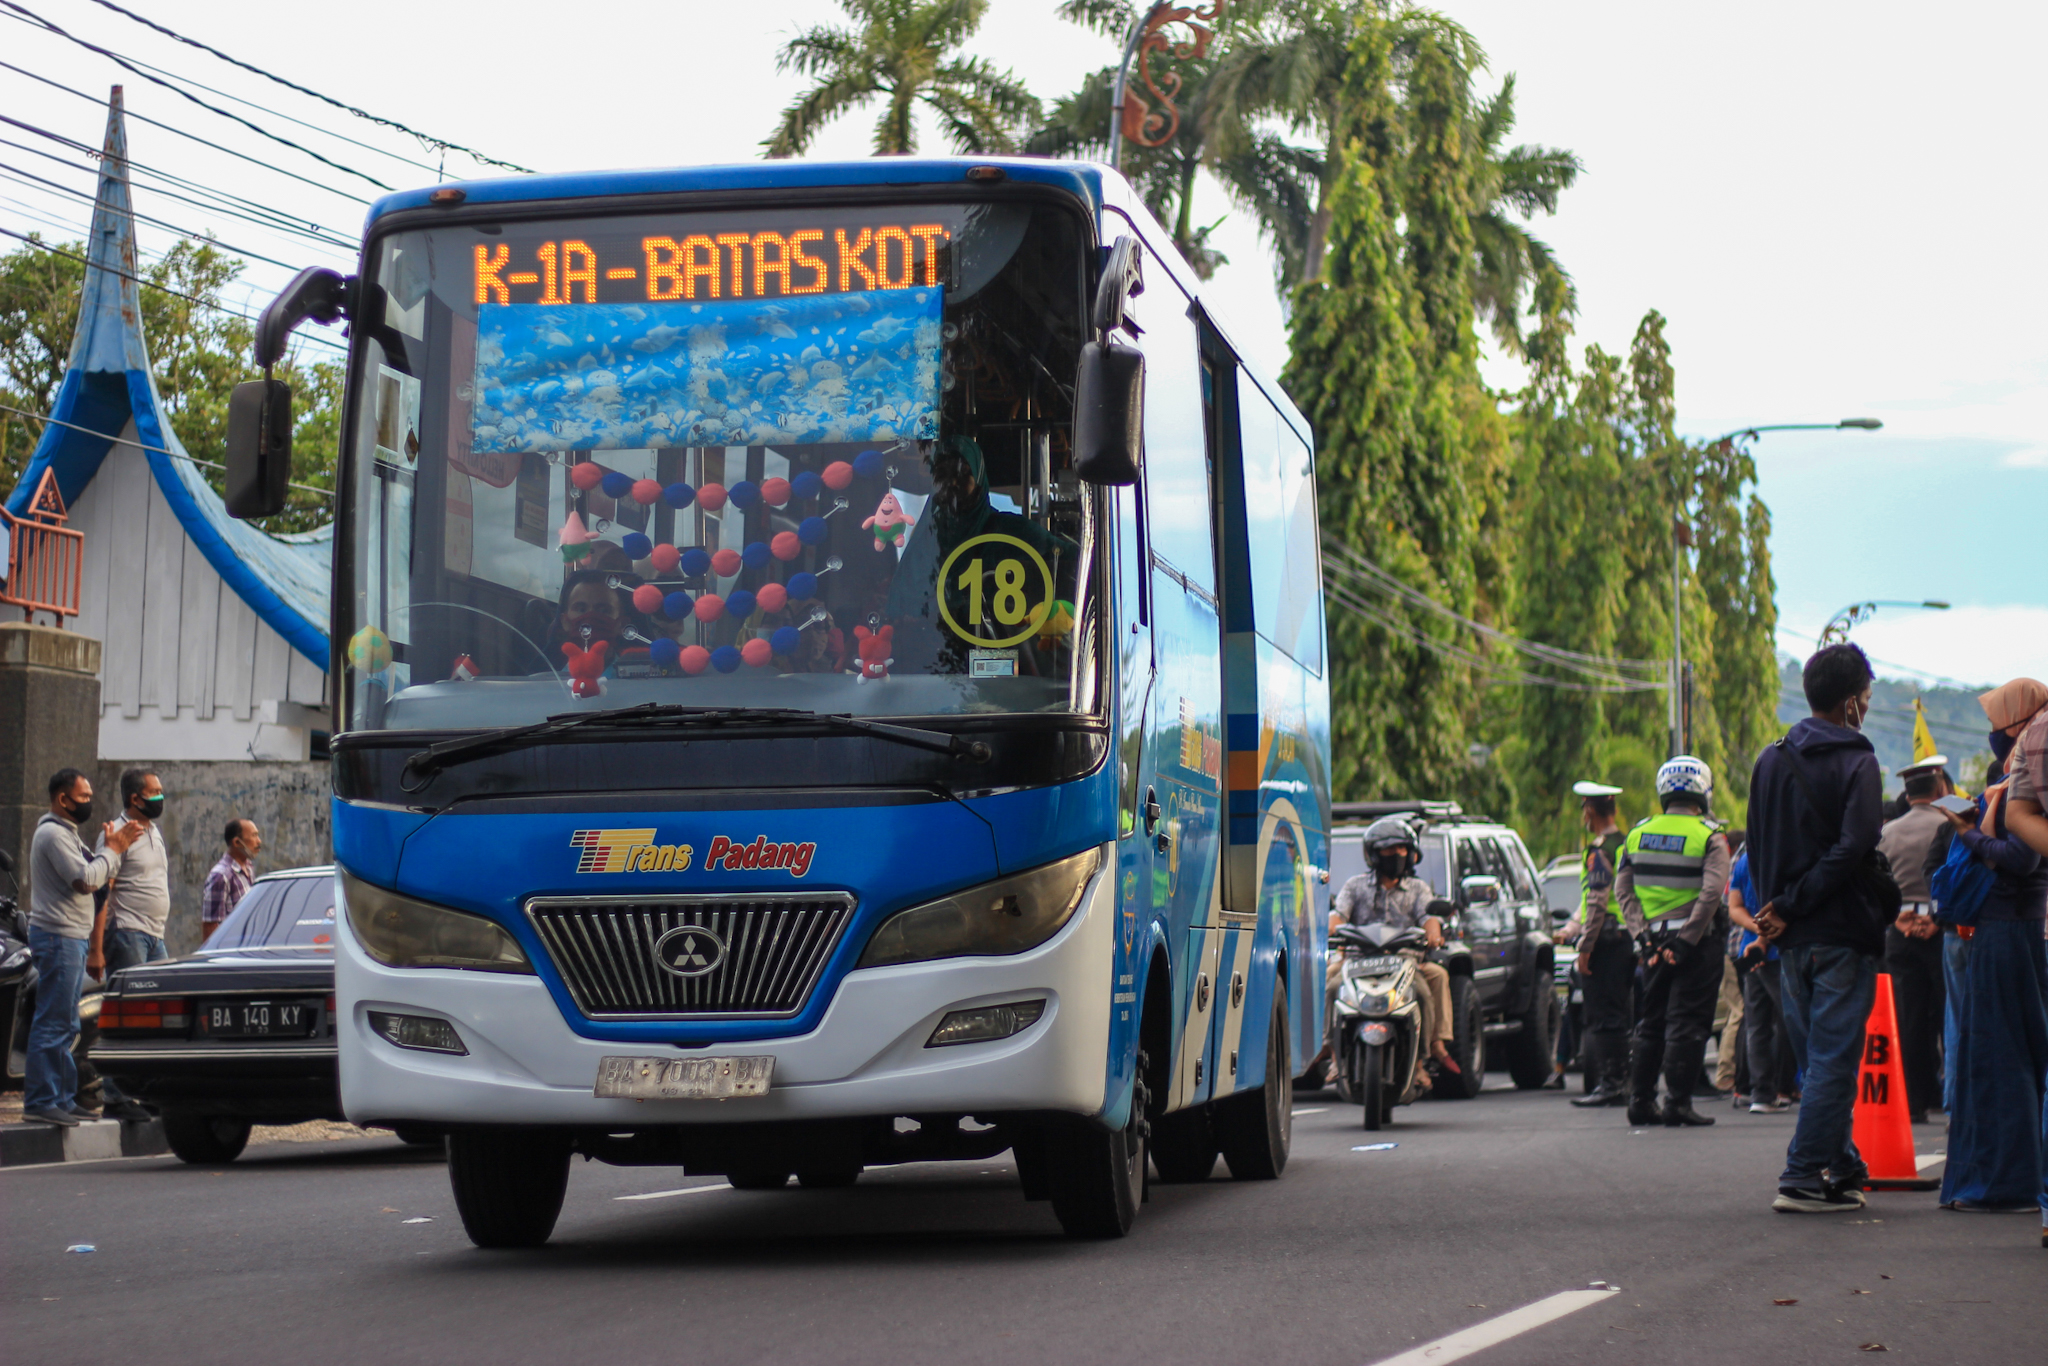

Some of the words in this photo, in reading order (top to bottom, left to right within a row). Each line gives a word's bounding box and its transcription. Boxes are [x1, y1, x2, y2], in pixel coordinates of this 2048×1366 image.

[642, 229, 828, 301] BATAS
[835, 224, 950, 292] KOT
[958, 558, 1027, 626] 18
[569, 828, 693, 874] Trans
[704, 835, 817, 878] Padang
[1640, 834, 1685, 852] POLISI
[212, 1007, 232, 1027] BA
[243, 1007, 269, 1026] 140
[281, 1005, 300, 1026] KY
[604, 1059, 634, 1084] BA
[654, 1059, 717, 1084] 7003
